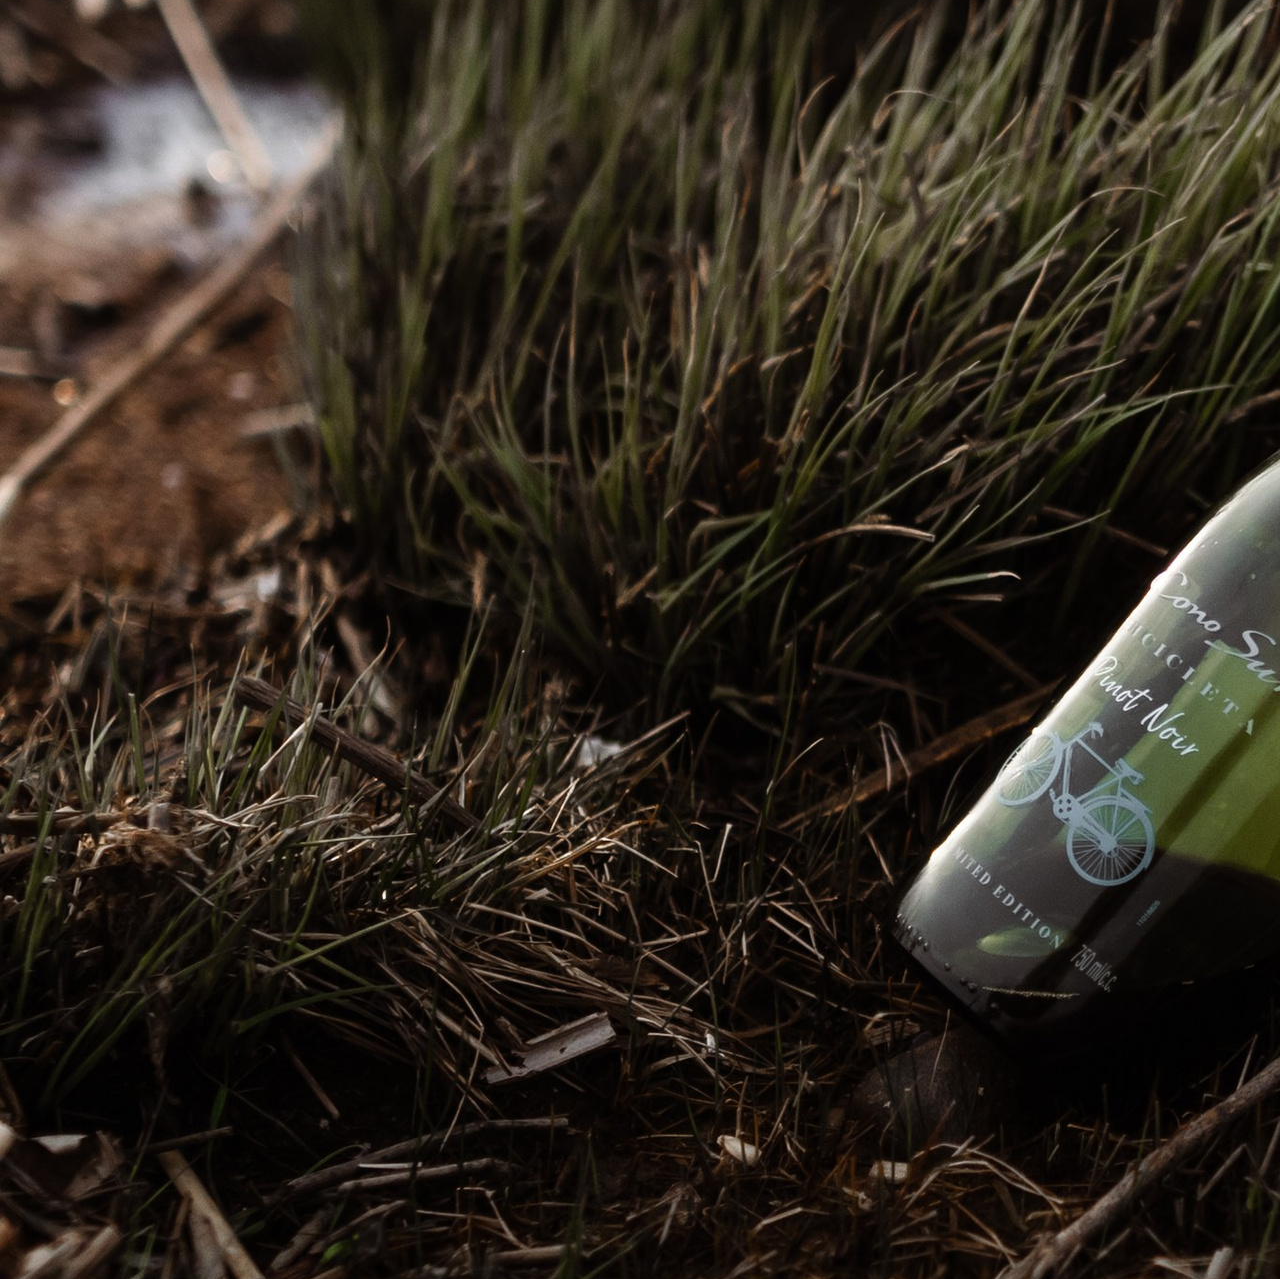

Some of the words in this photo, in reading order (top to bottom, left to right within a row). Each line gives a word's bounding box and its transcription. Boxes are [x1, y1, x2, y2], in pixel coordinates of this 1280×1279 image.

[1153, 570, 1221, 632] Cono
[1092, 655, 1153, 711] Pinot
[1140, 703, 1199, 755] Noir
[952, 847, 991, 885] MITED
[992, 884, 1064, 949] EDITION
[1070, 944, 1097, 971] 750
